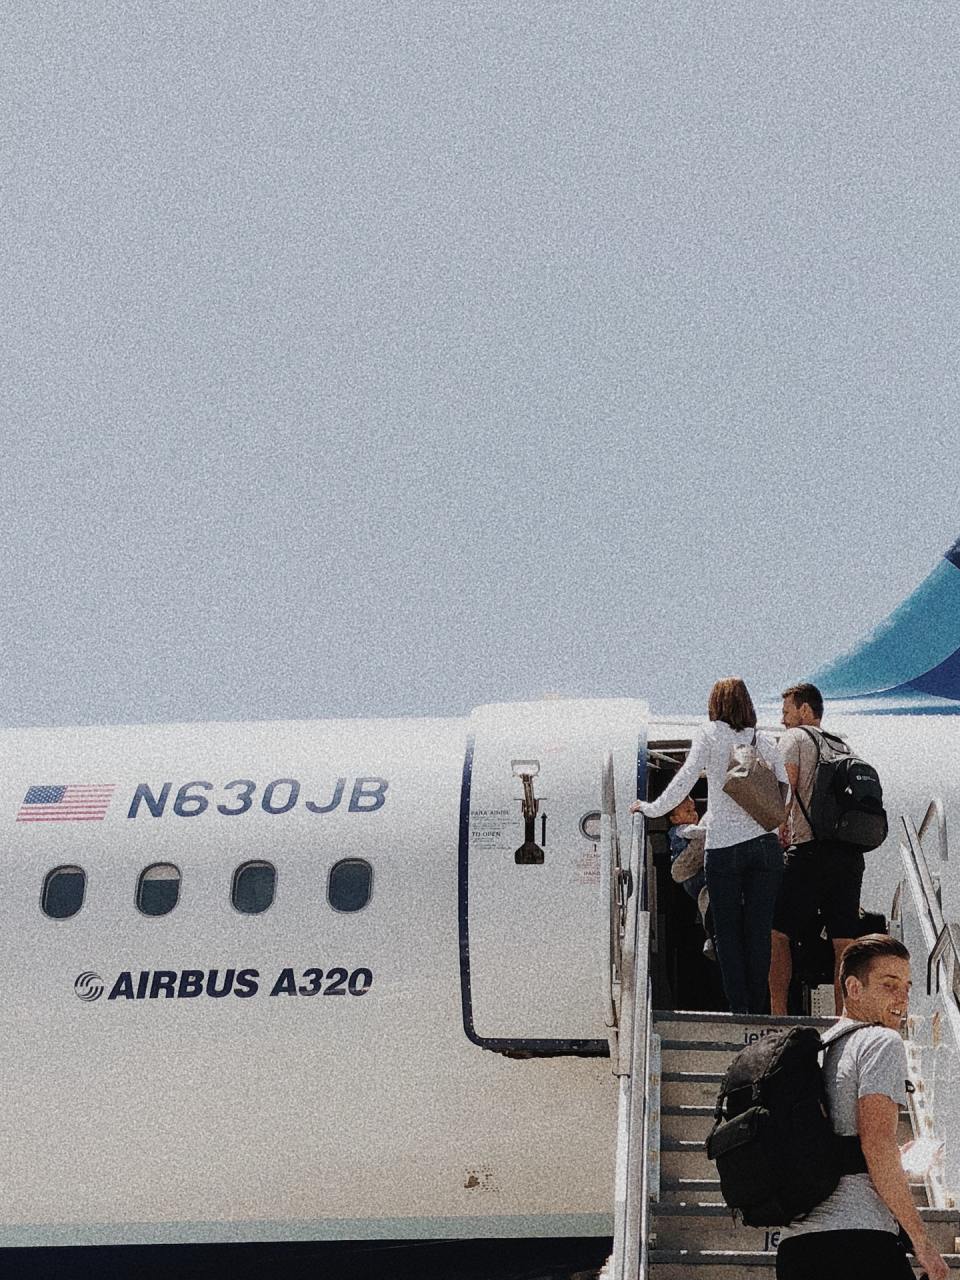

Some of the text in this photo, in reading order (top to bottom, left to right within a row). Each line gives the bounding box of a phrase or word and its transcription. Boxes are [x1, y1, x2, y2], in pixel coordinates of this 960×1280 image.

[127, 777, 390, 819] N630JB
[107, 967, 374, 1000] AIRBUS A320
